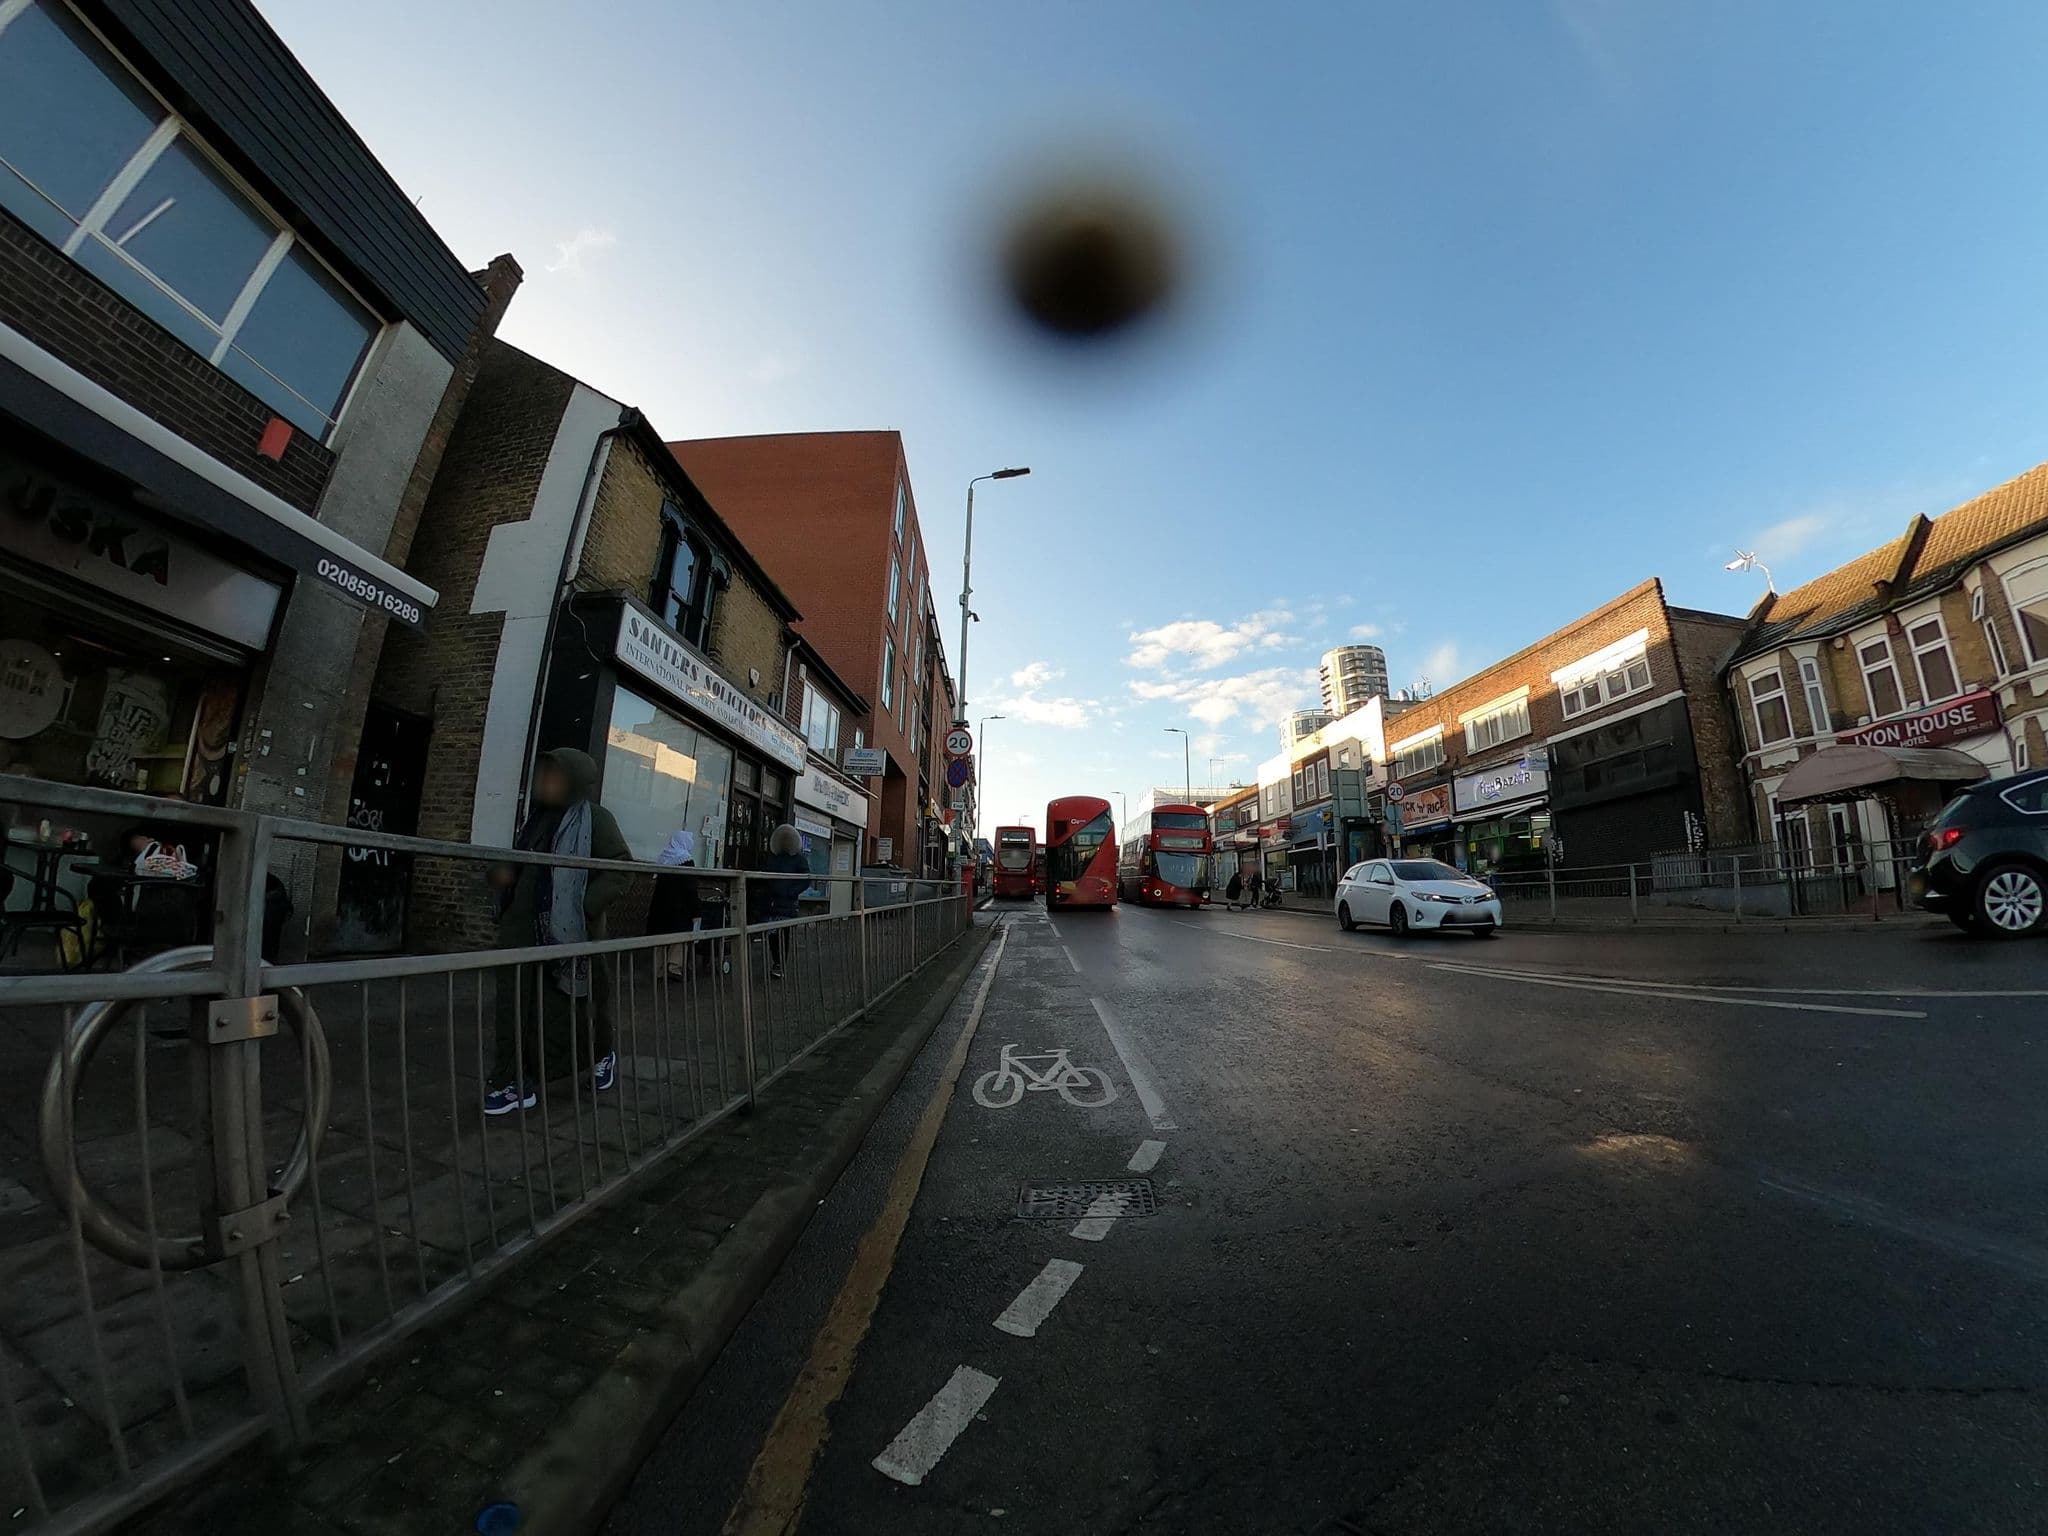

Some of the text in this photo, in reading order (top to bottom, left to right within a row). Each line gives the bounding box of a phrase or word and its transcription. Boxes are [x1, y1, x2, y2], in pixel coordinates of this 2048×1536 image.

[317, 559, 419, 624] 02085916289
[625, 642, 684, 692] INTERNATIONAL
[629, 617, 769, 731] SANTERS SOLICITORS
[1905, 704, 1977, 738] HOUSE
[949, 737, 969, 748] 20
[1900, 735, 1930, 748] HOTEL
[1390, 787, 1403, 796] 20
